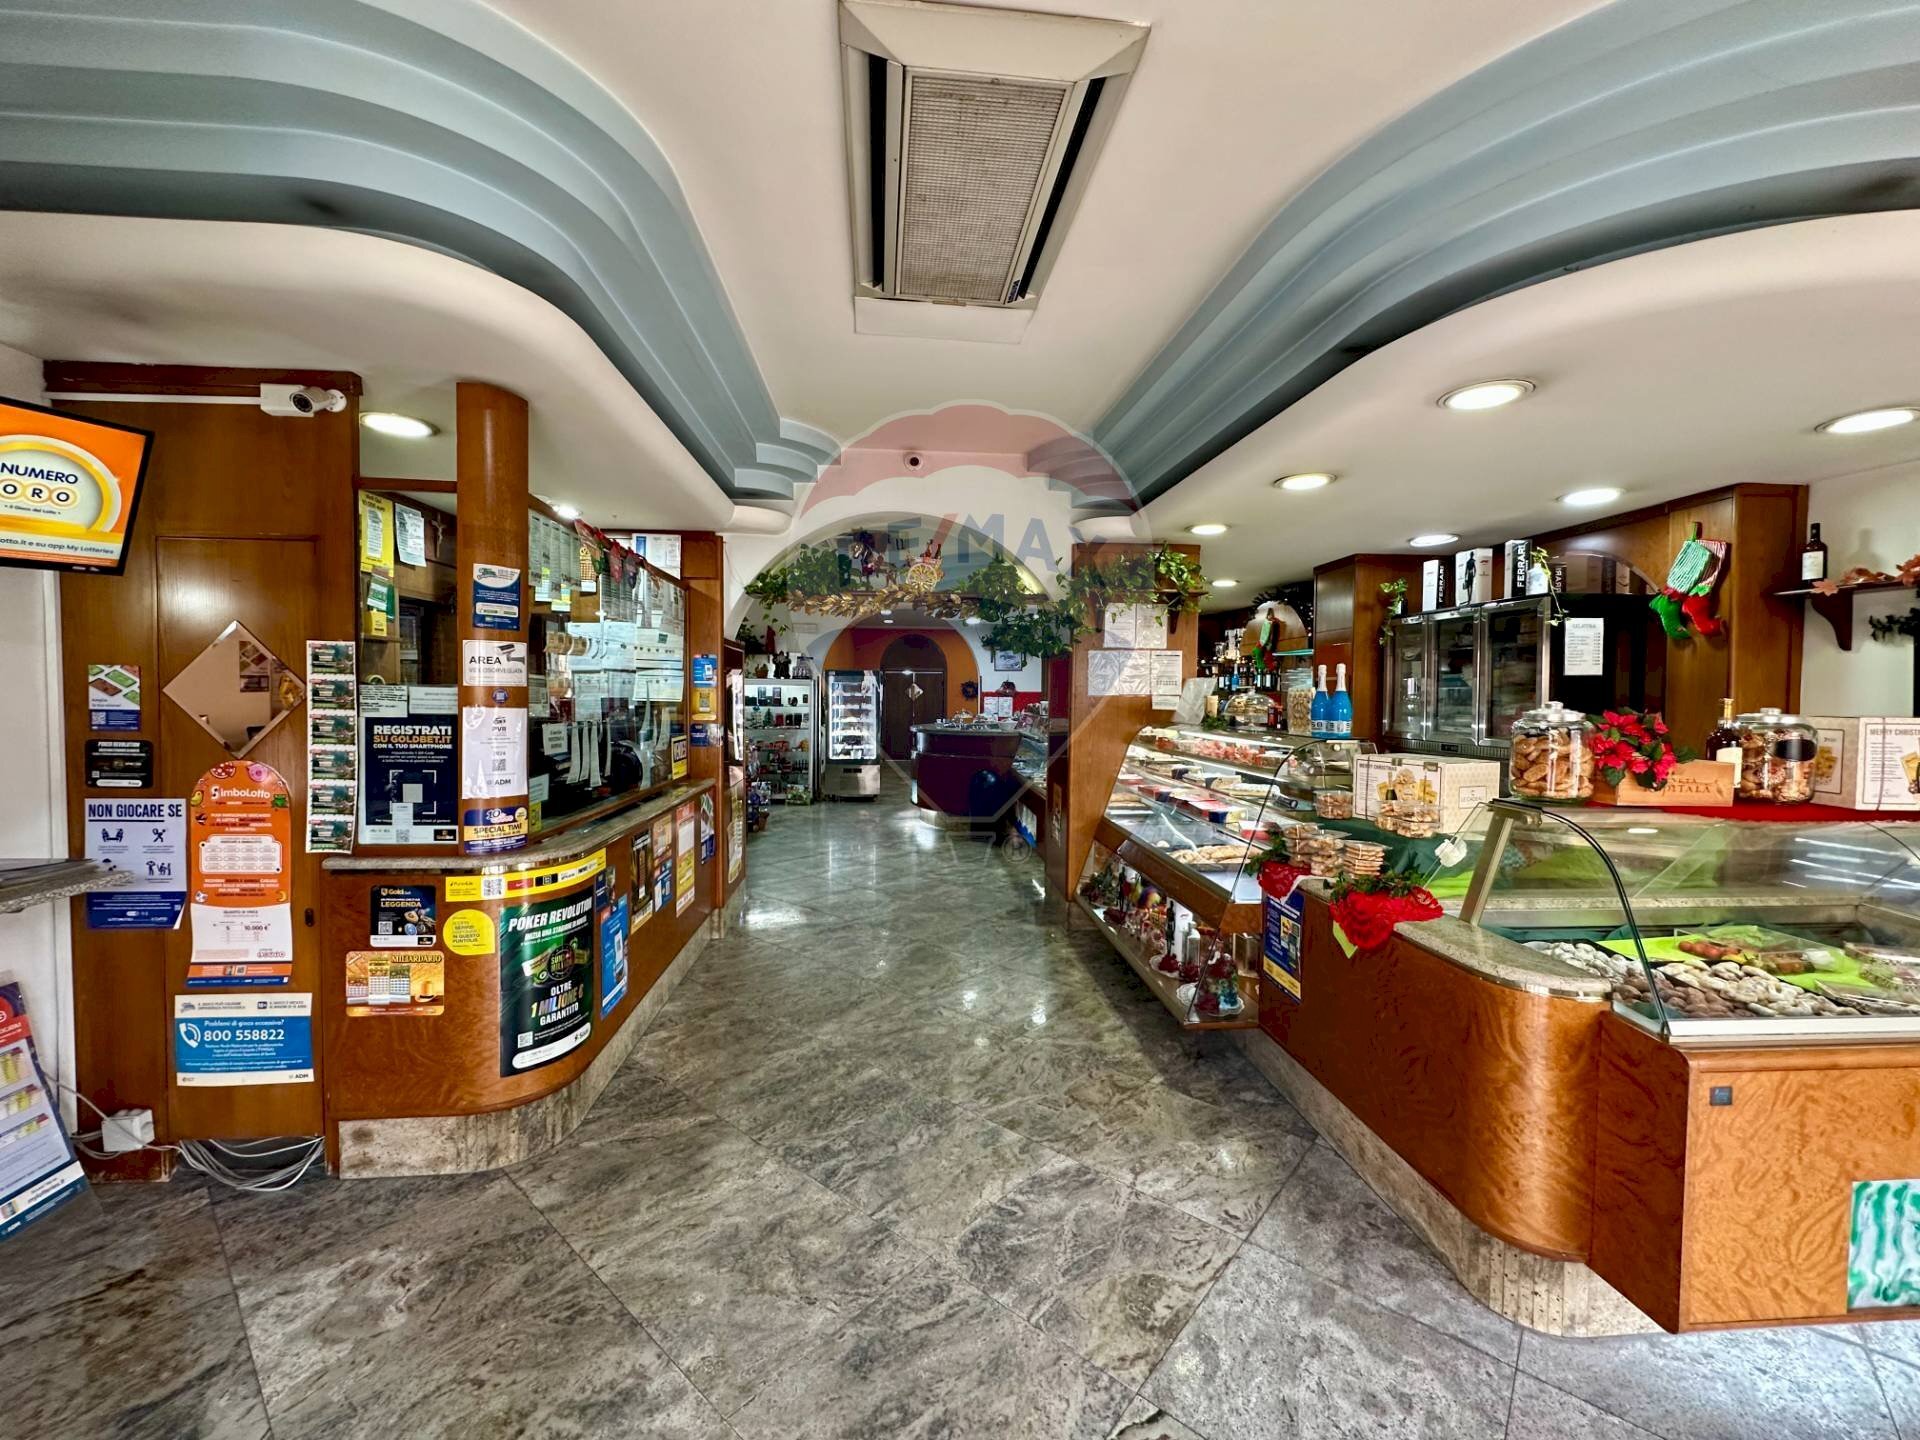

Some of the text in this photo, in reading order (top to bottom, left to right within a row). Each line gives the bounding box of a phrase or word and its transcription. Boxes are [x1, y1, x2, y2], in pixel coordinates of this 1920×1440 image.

[1, 462, 79, 485] NUMERO
[1516, 541, 1526, 588] FERRARI
[469, 656, 502, 665] AREA
[373, 725, 453, 736] REGISTRATI
[373, 735, 453, 744] SU GOLDBET.IT
[210, 785, 271, 800] SimboLotto
[88, 804, 182, 818] NON GIOCARE SE
[474, 825, 506, 835] SPECIAL
[508, 912, 548, 932] POKER
[549, 897, 593, 924] REVOLUTION
[391, 954, 442, 964] MILIARDARIO
[550, 980, 573, 996] OLTRE
[539, 986, 578, 1016] MILIONE
[540, 1001, 579, 1026] GARANTITO
[203, 1029, 285, 1041] 800 558822
